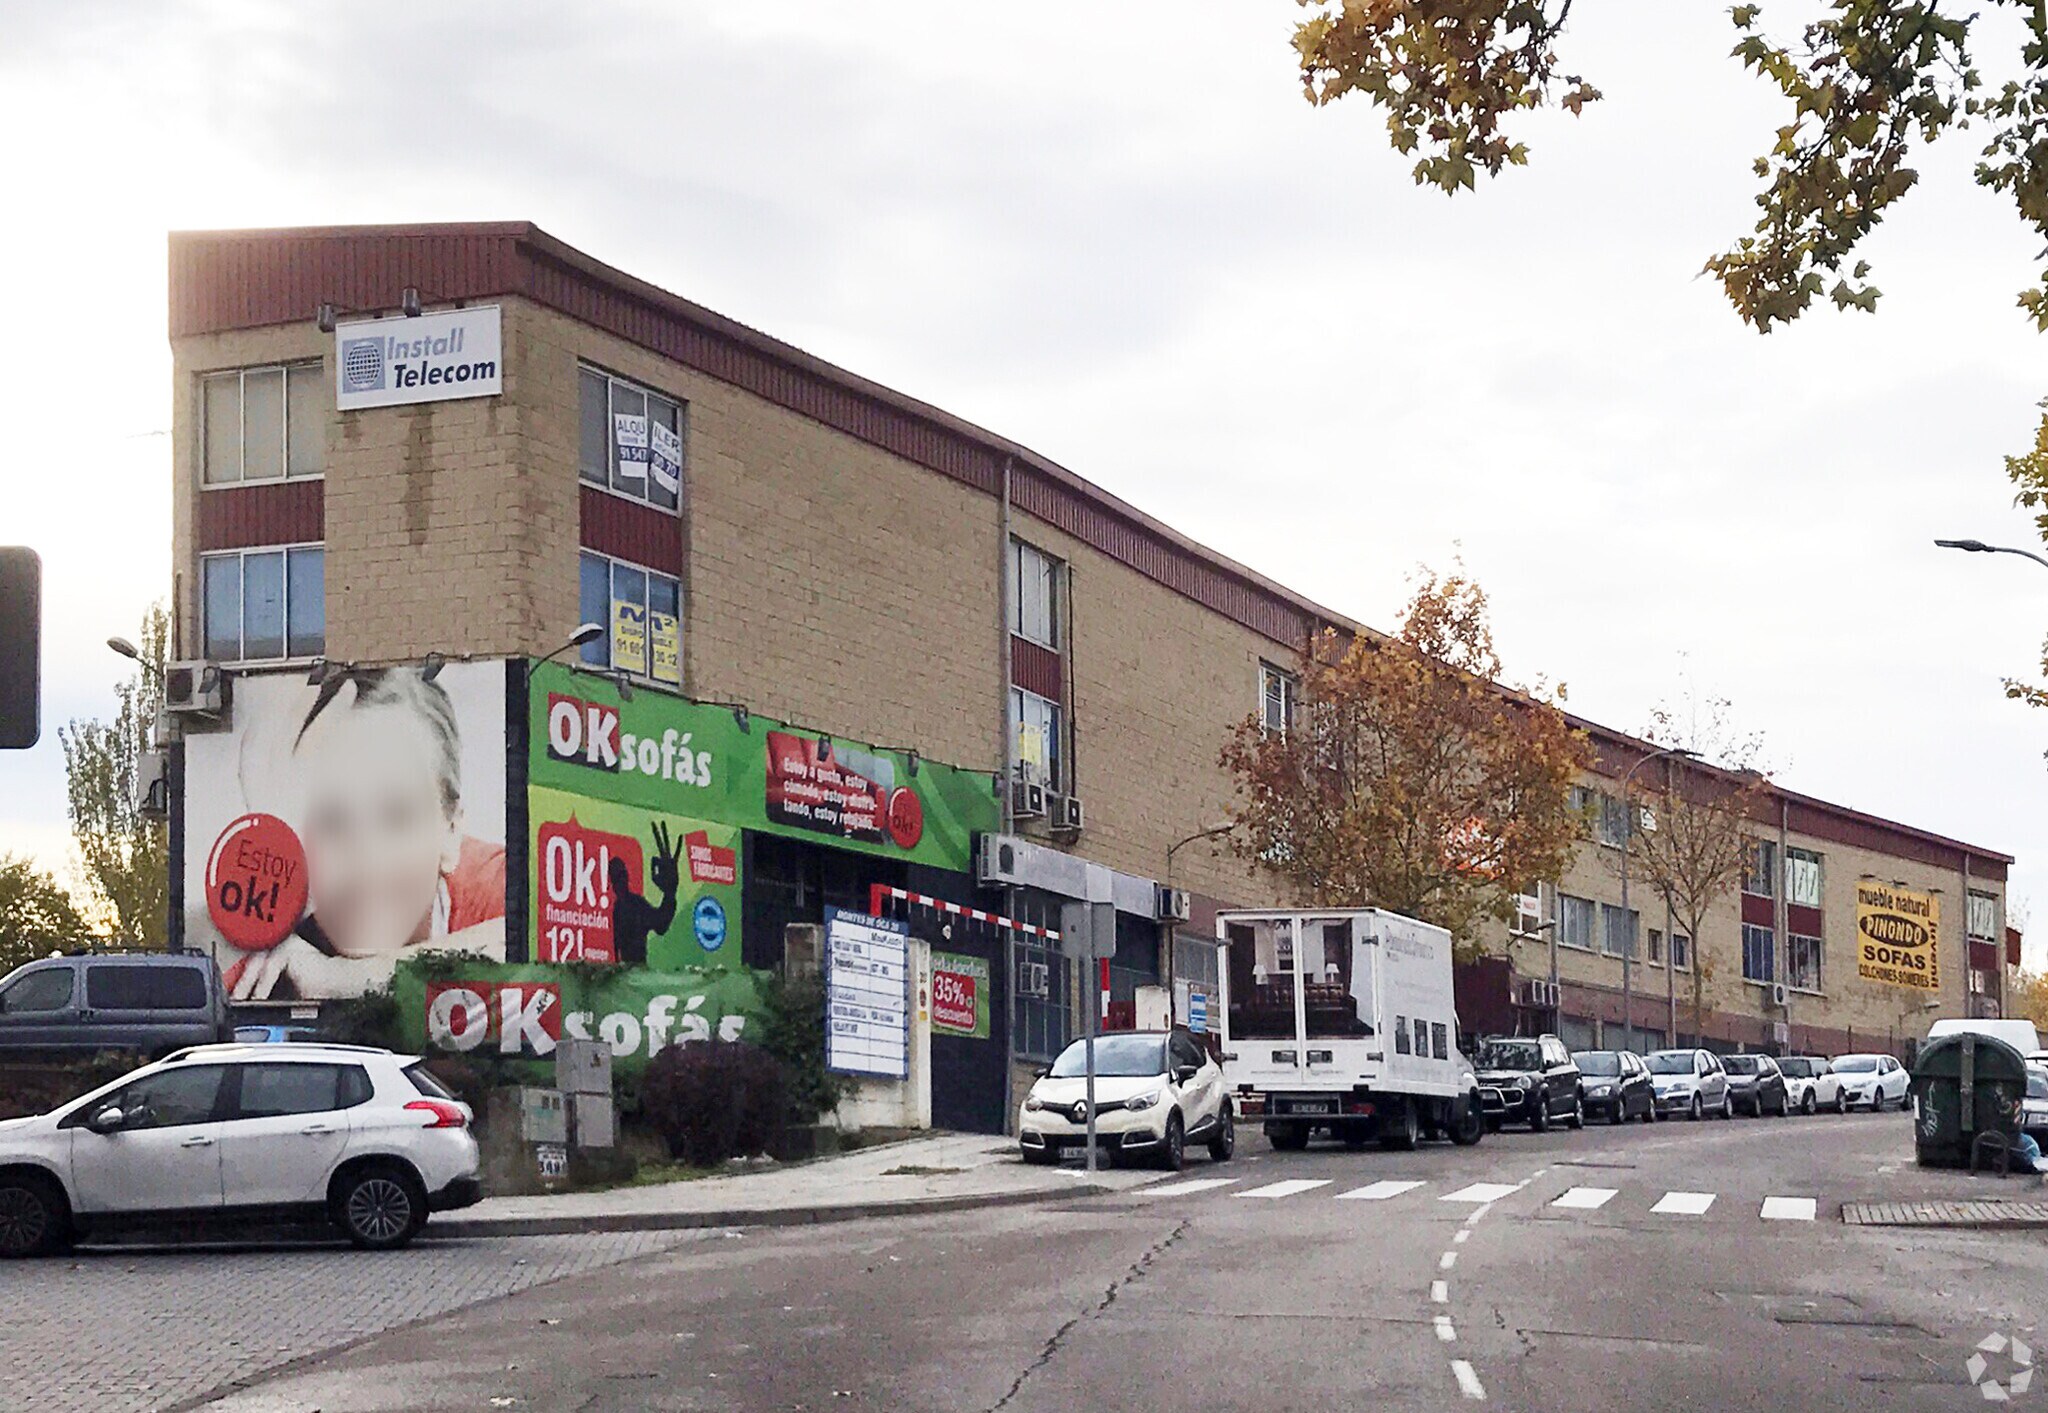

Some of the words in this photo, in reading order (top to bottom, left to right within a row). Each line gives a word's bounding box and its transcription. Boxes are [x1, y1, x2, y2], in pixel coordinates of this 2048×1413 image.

[388, 327, 465, 360] Install
[394, 361, 495, 388] Telecom
[809, 767, 816, 778] a
[845, 774, 868, 793] estoy
[784, 798, 812, 819] tando,
[814, 806, 838, 825] estoy
[823, 789, 847, 808] estoy
[237, 840, 298, 888] Estoy
[220, 877, 280, 922] ok!
[1858, 888, 1894, 910] mueble
[1896, 895, 1930, 917] natural
[546, 903, 609, 929] financiación
[1866, 915, 1923, 945] PINONDO
[1863, 945, 1926, 970] SOFAS
[935, 975, 965, 1006] 35%
